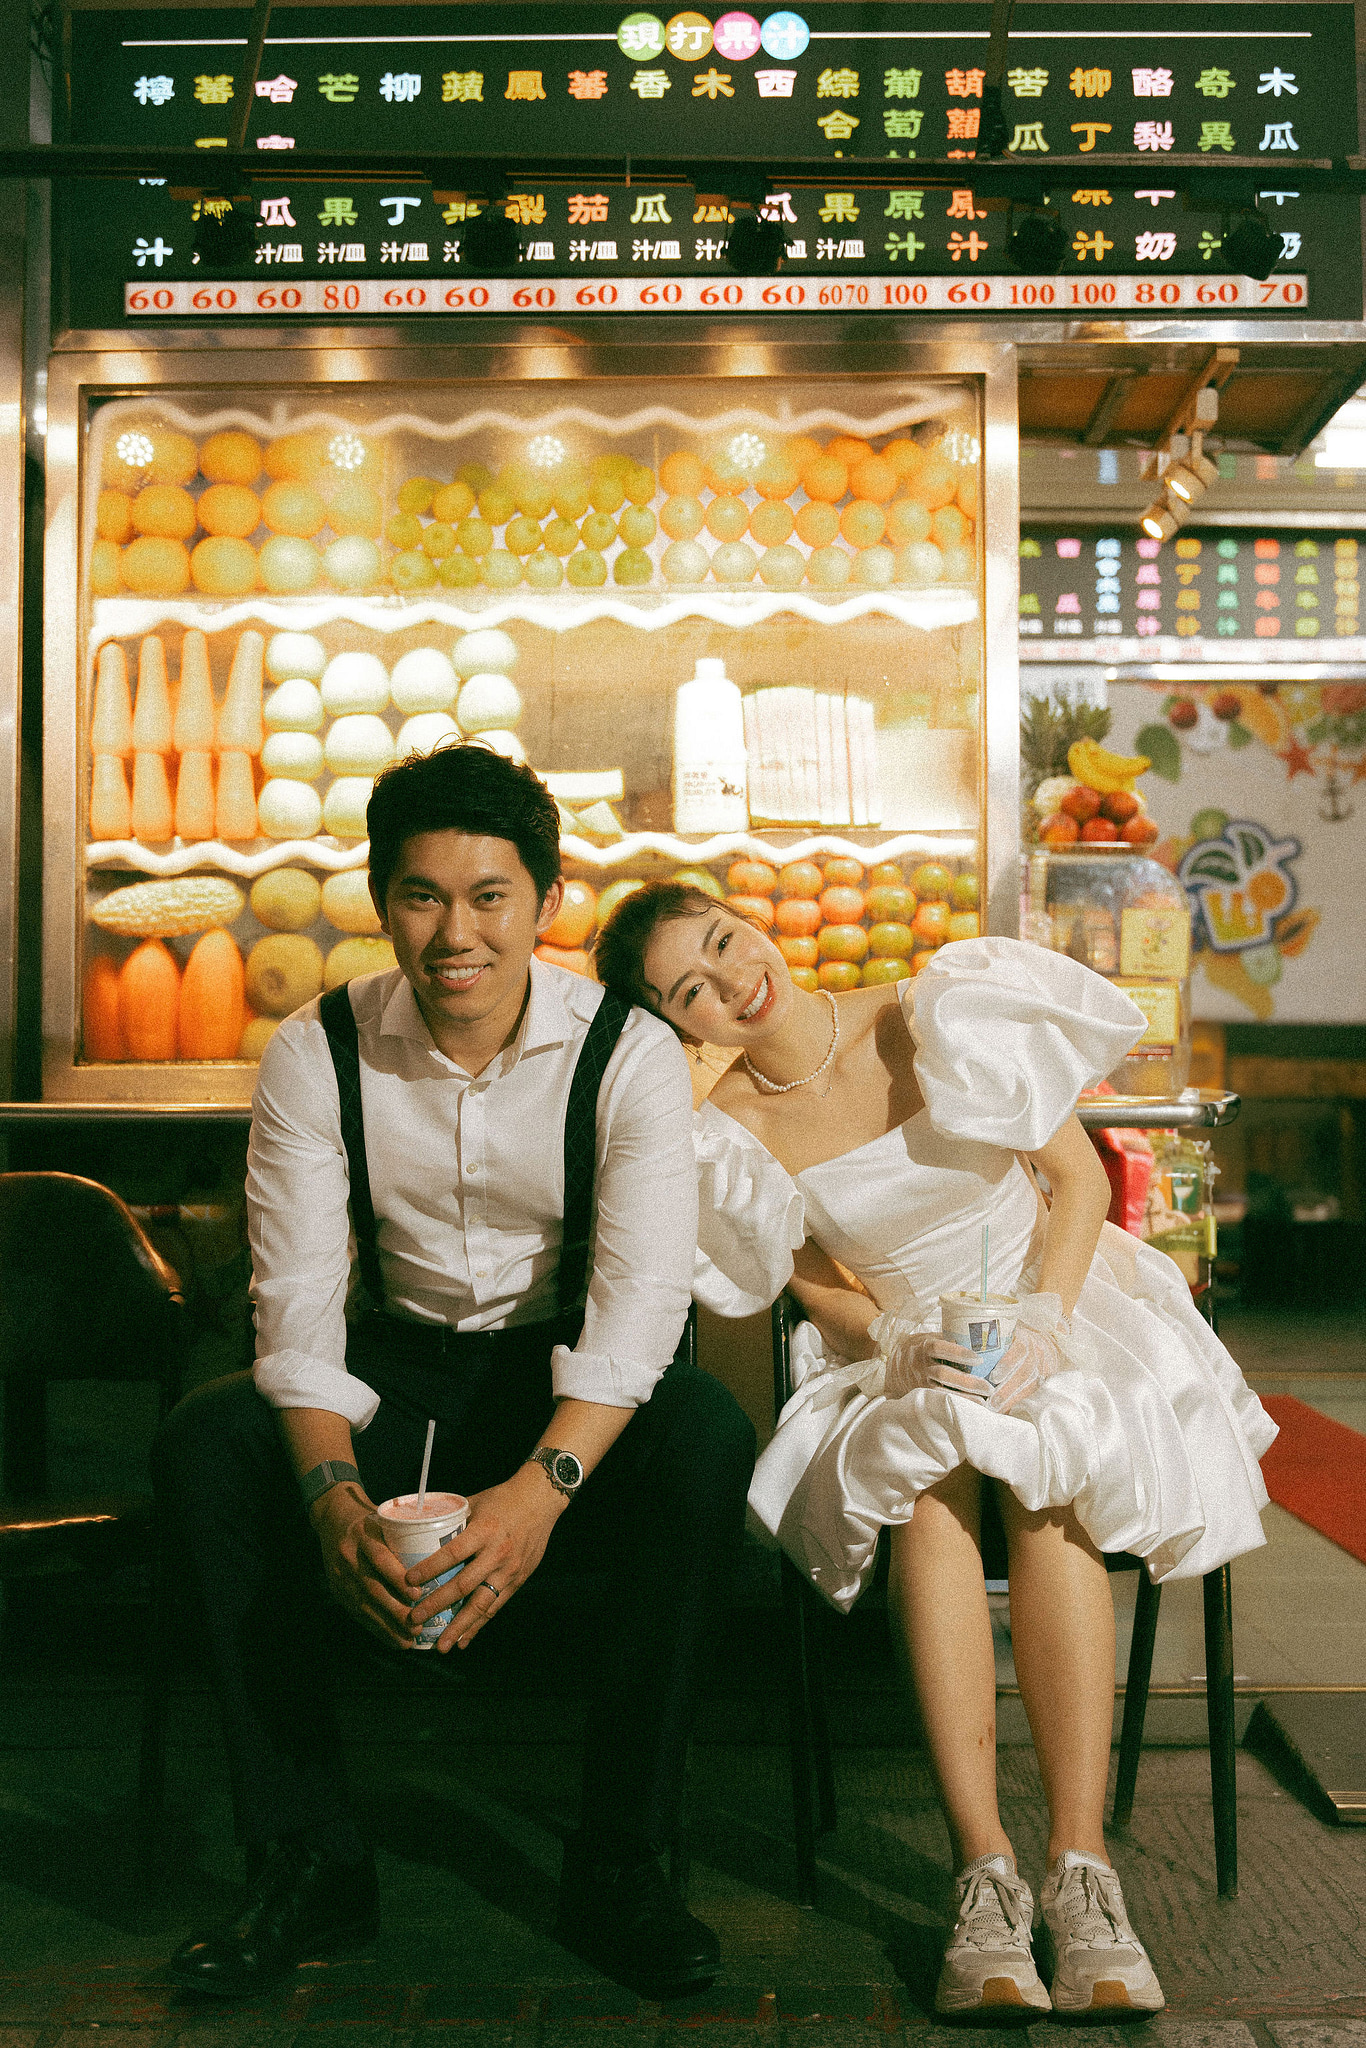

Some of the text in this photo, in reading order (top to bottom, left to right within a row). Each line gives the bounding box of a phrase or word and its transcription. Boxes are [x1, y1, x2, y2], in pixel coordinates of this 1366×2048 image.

[621, 21, 805, 50] 現打果汁
[883, 67, 926, 262] 葡萄原汁
[945, 67, 989, 262] 葫蘿原汁
[128, 289, 175, 310] 60
[191, 288, 238, 310] 60
[256, 287, 303, 309] 60
[323, 284, 361, 311] 80
[383, 287, 427, 307] 60
[444, 286, 490, 308] 60
[512, 286, 557, 308] 60
[575, 284, 619, 306] 60
[639, 284, 683, 305] 60
[699, 285, 744, 306] 60
[761, 284, 806, 305] 60
[883, 283, 928, 305] 100
[947, 282, 991, 304] 60
[1011, 283, 1056, 305] 100
[1070, 282, 1117, 305] 100
[1134, 283, 1181, 304] 80
[1196, 283, 1239, 304] 60
[1259, 283, 1304, 304] 70
